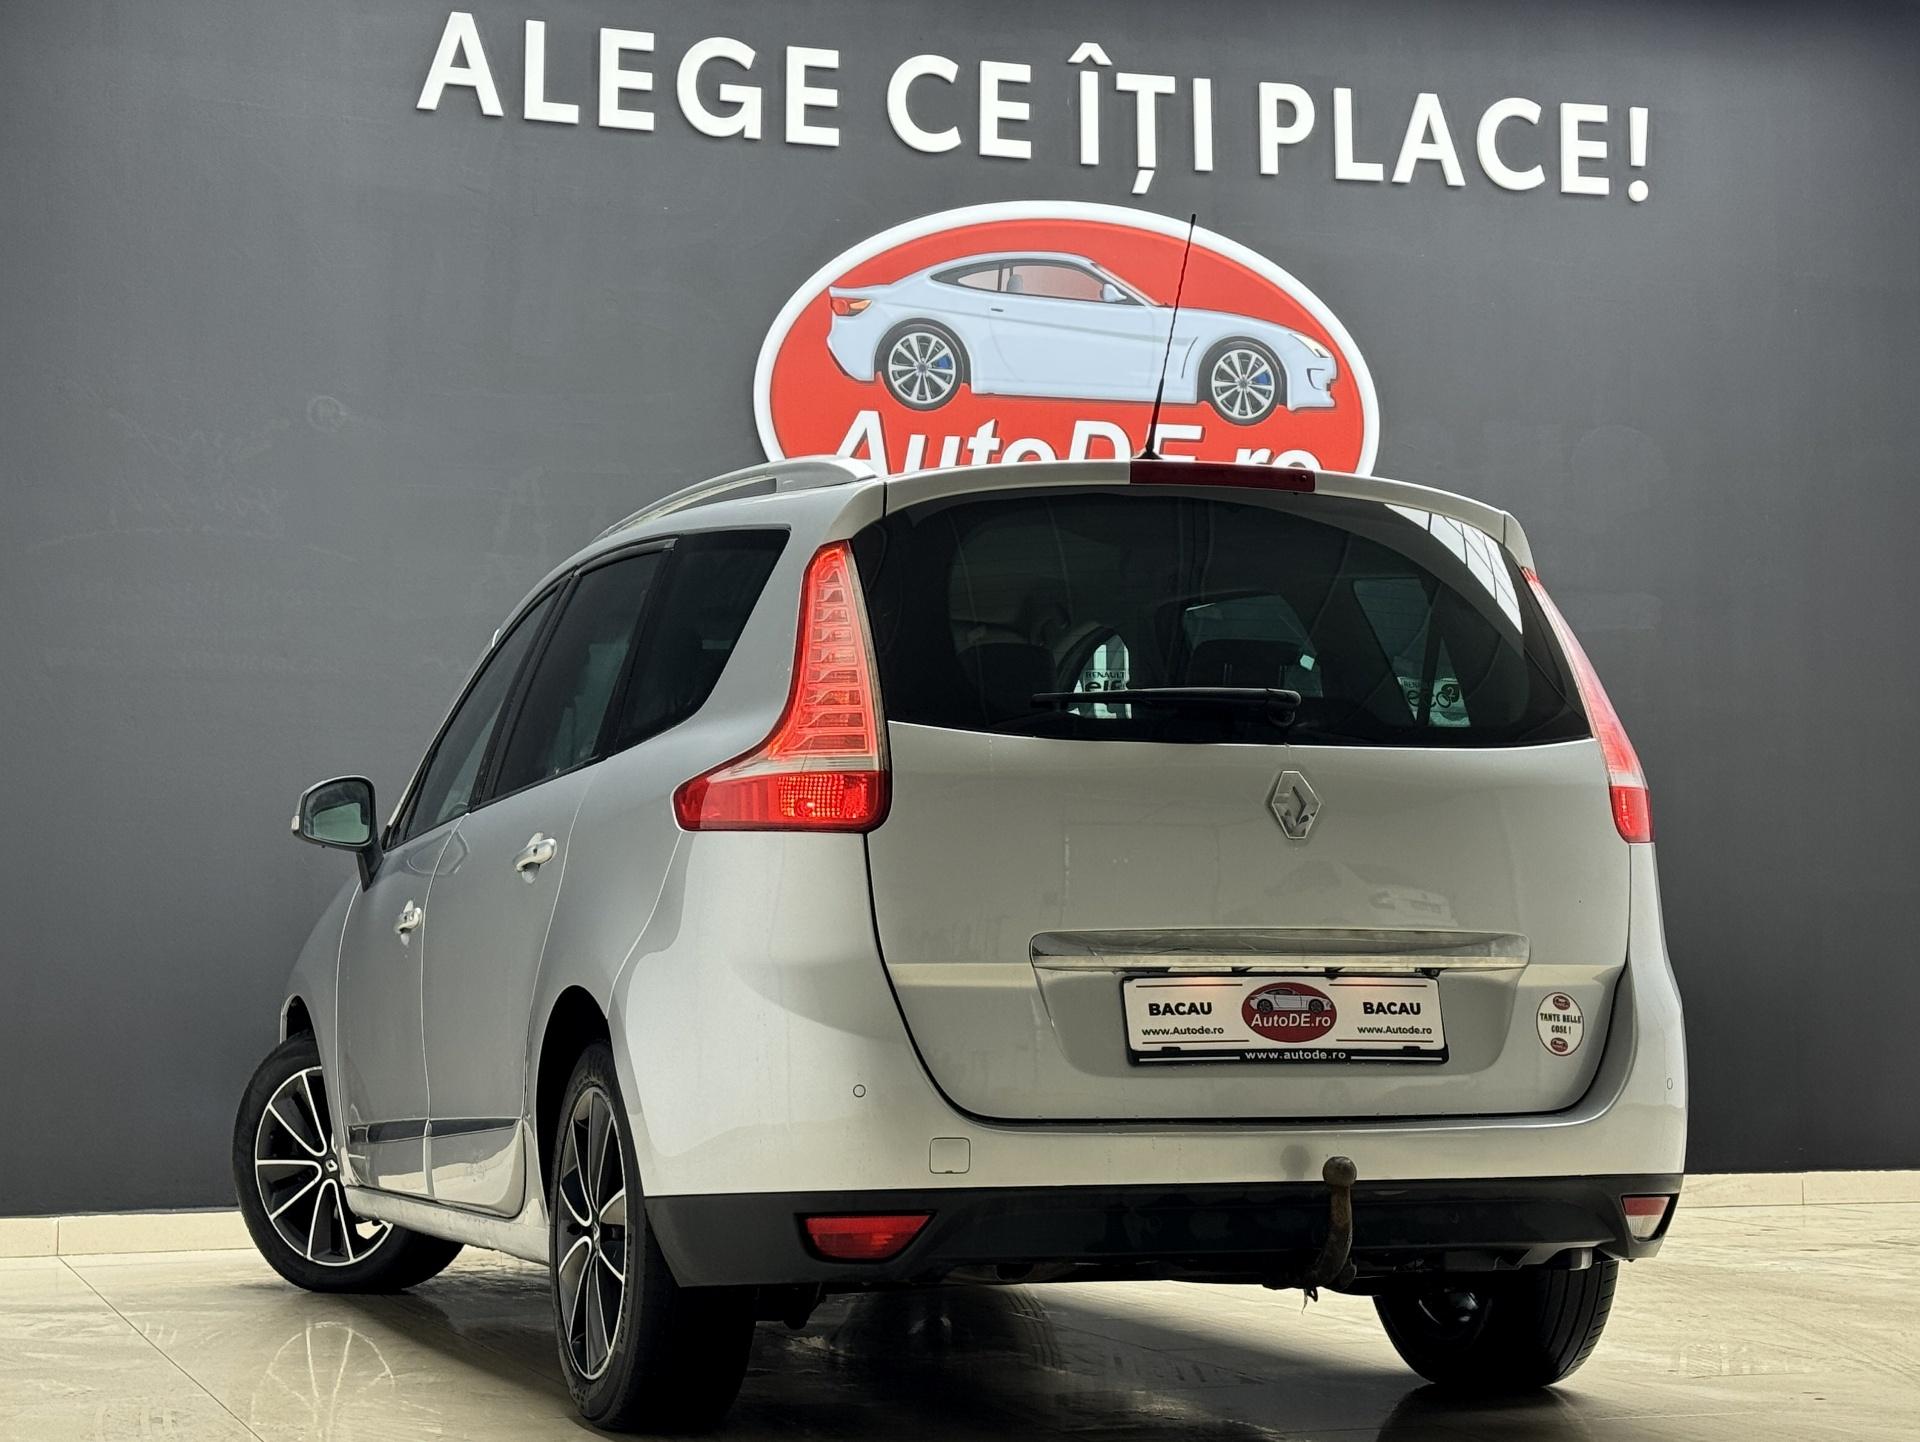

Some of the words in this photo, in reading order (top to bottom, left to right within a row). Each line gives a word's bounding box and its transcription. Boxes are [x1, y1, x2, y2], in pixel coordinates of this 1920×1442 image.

[416, 10, 841, 148] ALEGE
[887, 53, 1032, 160] CE
[1067, 41, 1214, 195] ÎȚI
[1258, 81, 1650, 203] PLACE!
[835, 409, 1322, 476] AutDE
[1085, 671, 1125, 679] RENAULT
[1148, 1002, 1213, 1016] BACAU
[1362, 1001, 1422, 1015] BACAU
[1250, 1013, 1331, 1027] AutoDE.ro
[1540, 1012, 1561, 1022] TANTE
[1562, 1014, 1582, 1024] BELLE
[1141, 1025, 1225, 1036] www.Autode.ro
[1357, 1025, 1433, 1035] www.Autode.ro
[1244, 1049, 1346, 1060] www.autode.ro
